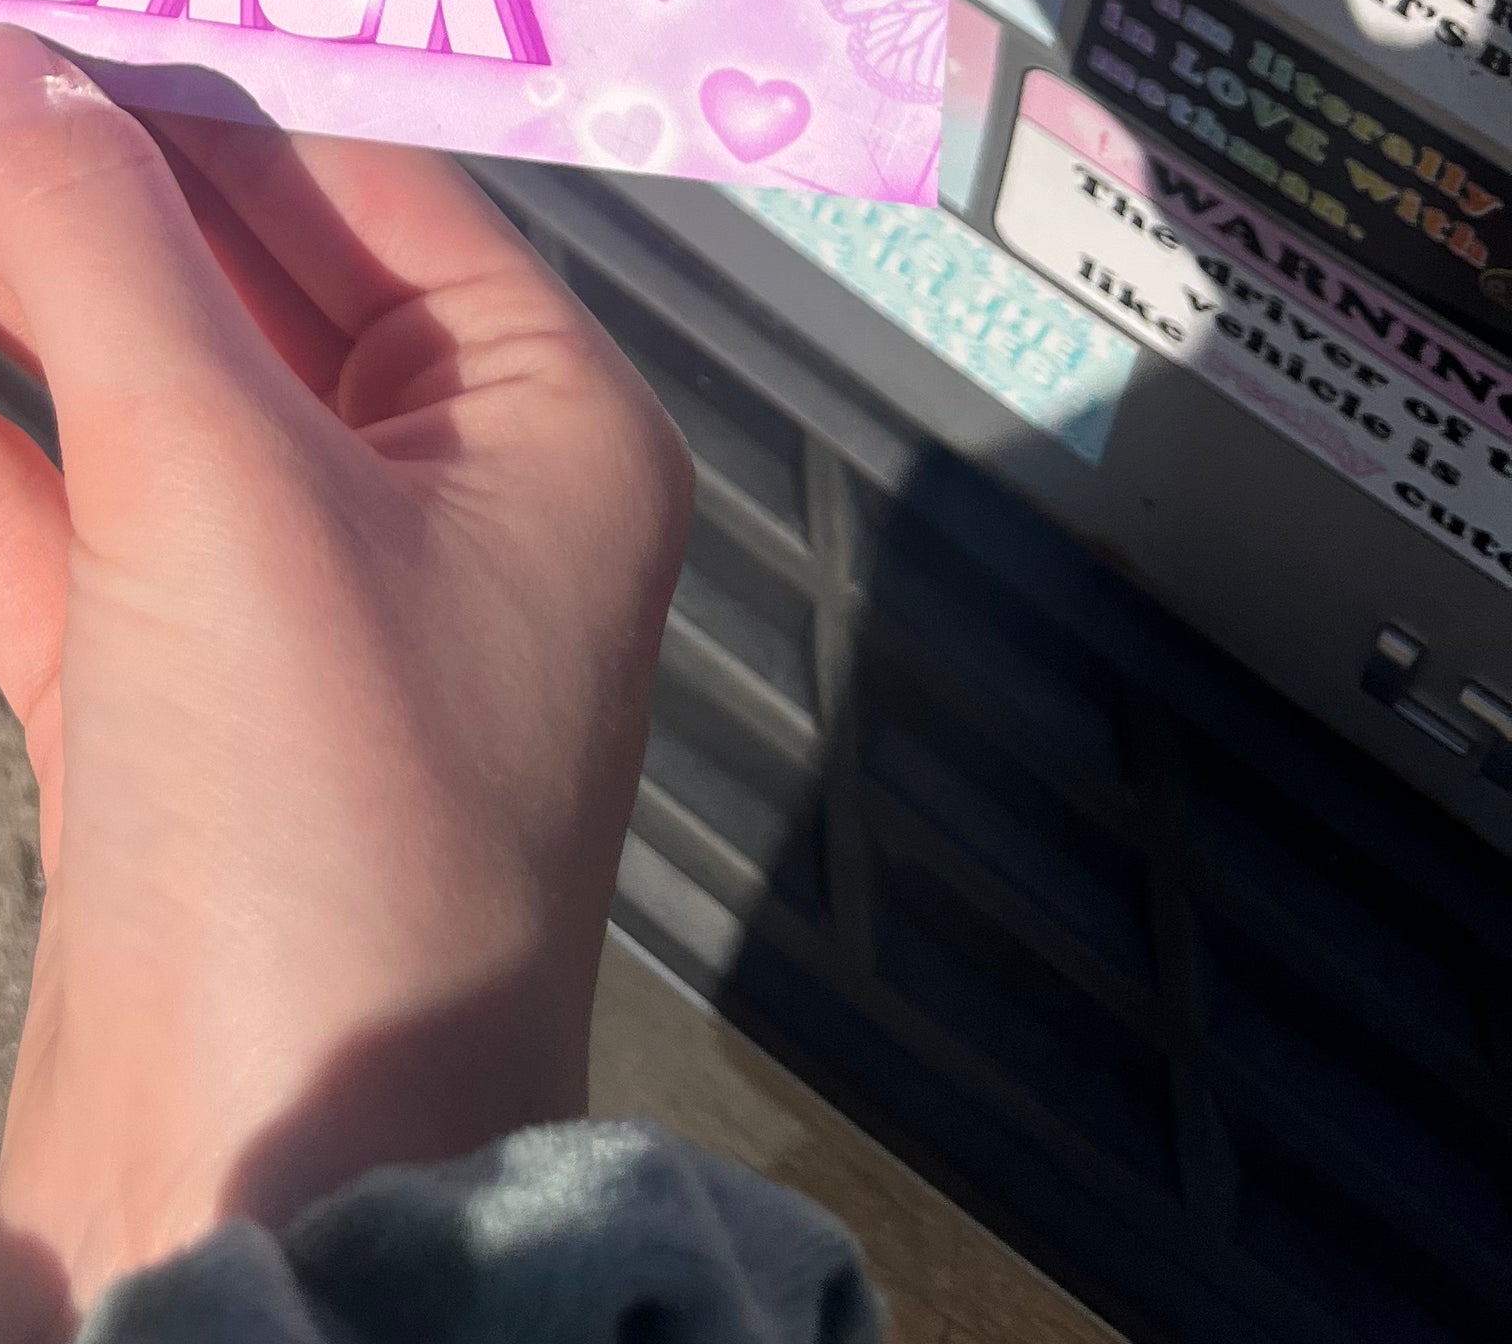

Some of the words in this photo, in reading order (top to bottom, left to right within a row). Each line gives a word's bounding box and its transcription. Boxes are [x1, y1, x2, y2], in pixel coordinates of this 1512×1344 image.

[1088, 44, 1367, 244] mothman.
[1247, 39, 1506, 217] literally
[1343, 157, 1490, 269] with
[1072, 162, 1183, 252] The
[1195, 254, 1390, 390] driver
[1401, 395, 1476, 450] of
[1079, 254, 1187, 344] like
[1181, 282, 1395, 443] vehicle
[1407, 436, 1463, 488] is
